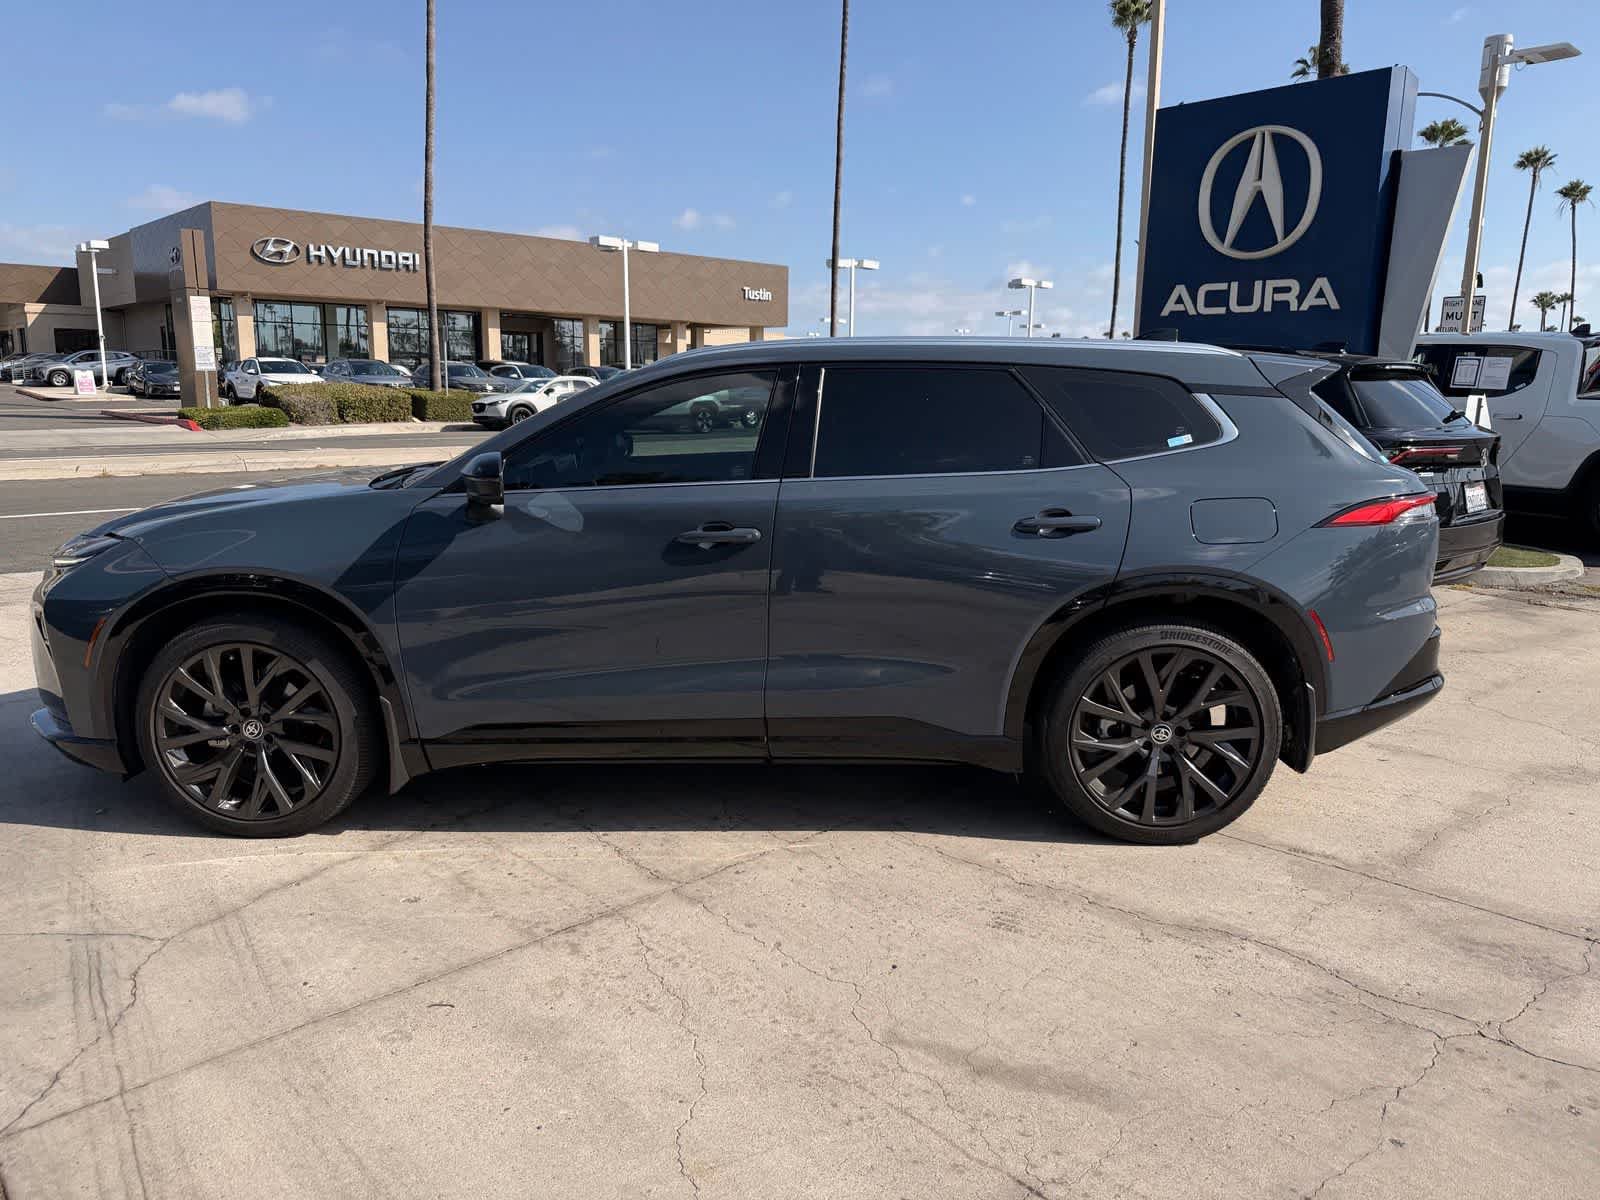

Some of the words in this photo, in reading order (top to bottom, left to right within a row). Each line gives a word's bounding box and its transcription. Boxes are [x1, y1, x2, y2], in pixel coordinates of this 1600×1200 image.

[308, 243, 419, 271] HYUNDAI
[743, 286, 772, 301] Tustin
[1160, 277, 1341, 316] ACURA
[1445, 311, 1479, 320] MUT
[1160, 630, 1233, 656] BRIDGESTONE
